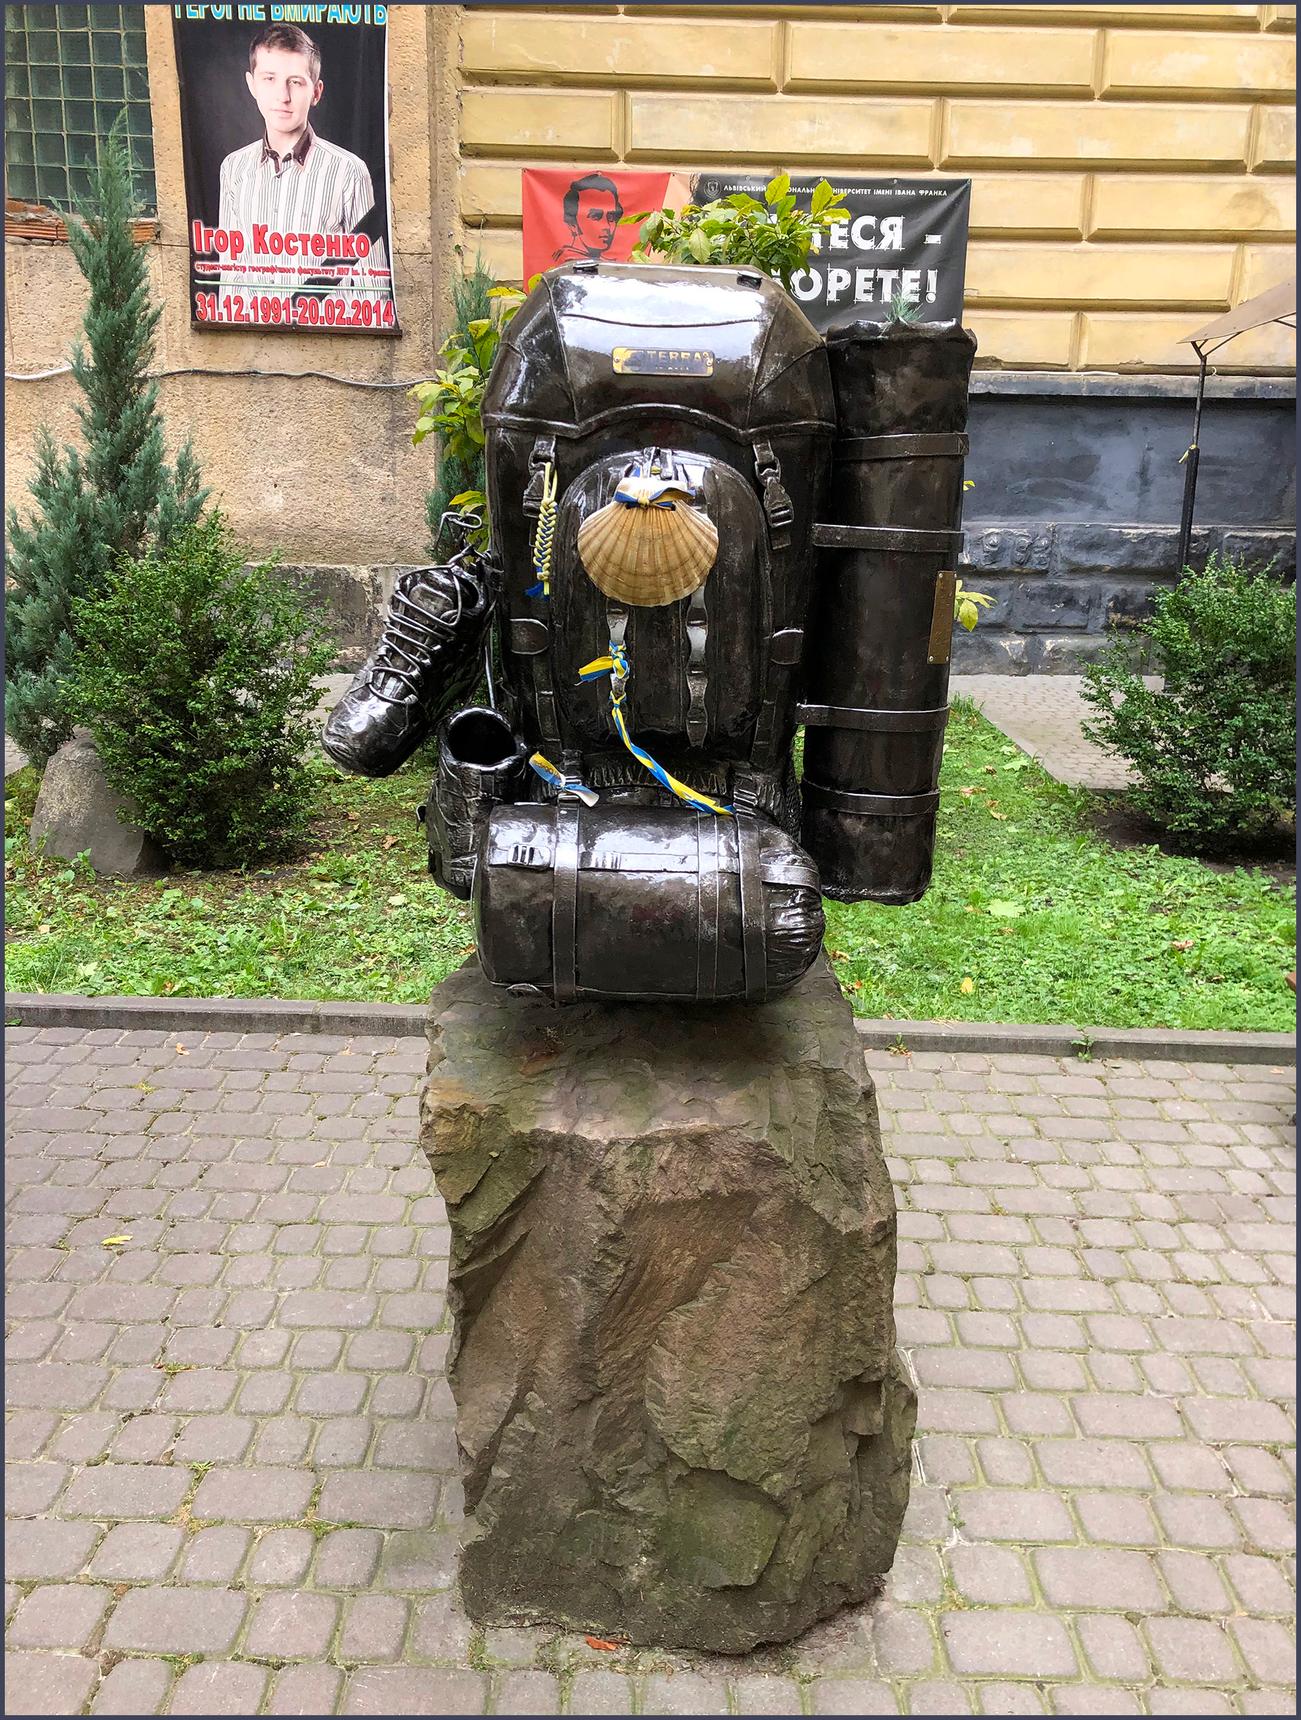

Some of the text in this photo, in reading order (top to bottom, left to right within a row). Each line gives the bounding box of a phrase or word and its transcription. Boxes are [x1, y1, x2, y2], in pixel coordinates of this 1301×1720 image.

[873, 188, 892, 196] ІМЕНІ
[895, 188, 916, 196] ІВАНА
[194, 221, 370, 260] Ігор Костенко
[196, 292, 394, 327] 31.12.1991-20.02.2014
